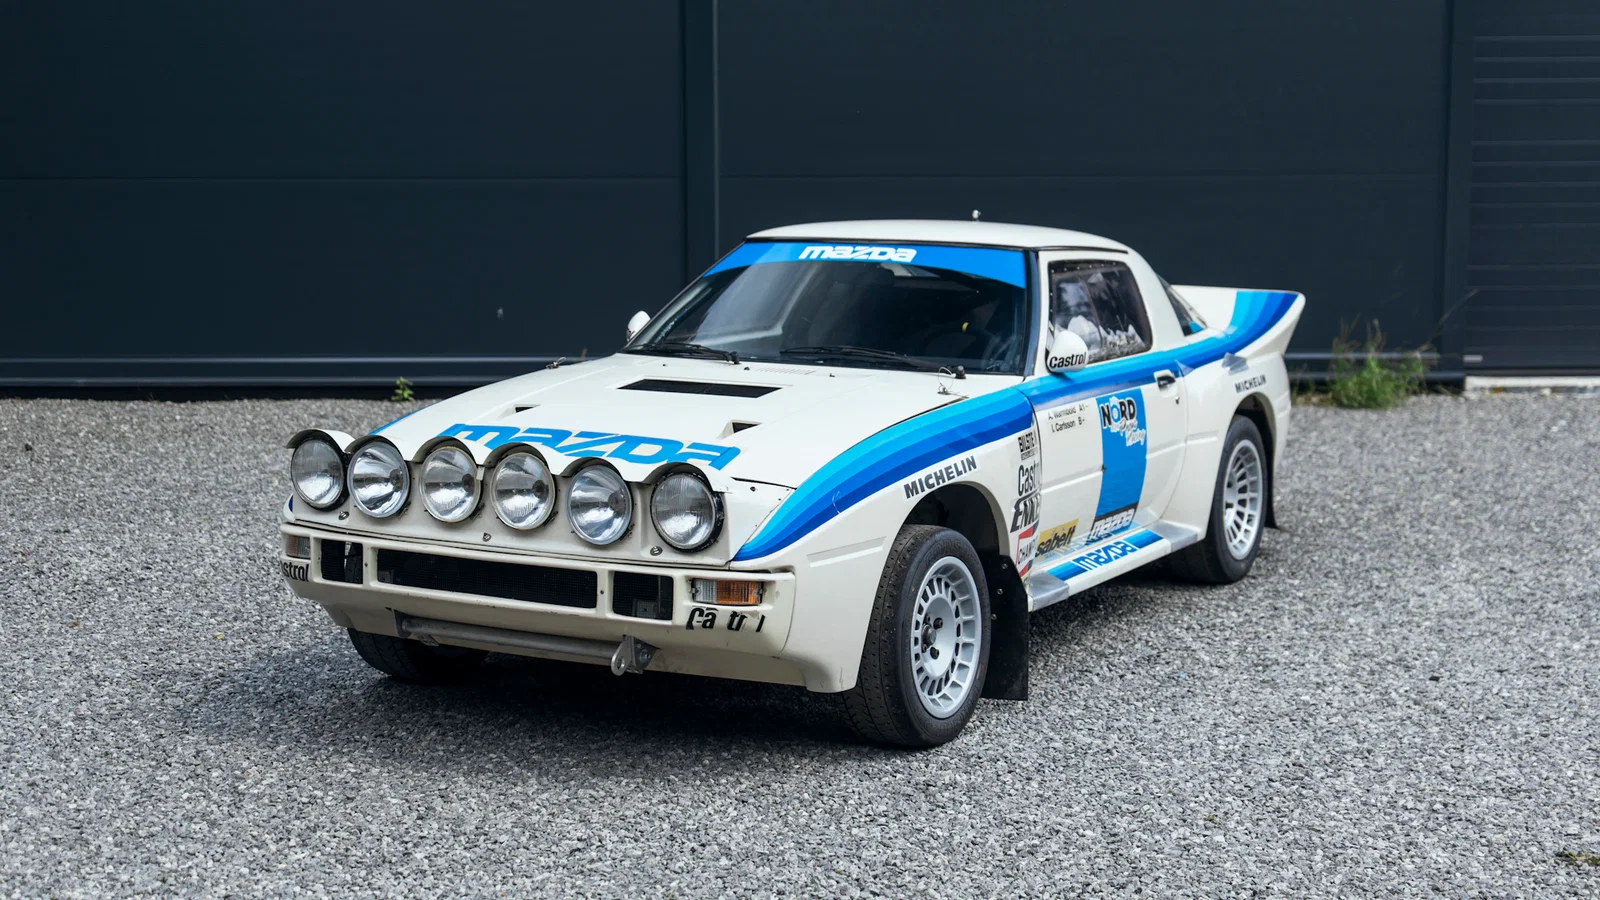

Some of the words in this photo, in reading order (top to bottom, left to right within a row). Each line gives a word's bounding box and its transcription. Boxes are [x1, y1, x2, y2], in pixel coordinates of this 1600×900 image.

[798, 245, 917, 263] mazda
[1049, 351, 1087, 369] Castrol
[1235, 374, 1267, 394] MICHELIN
[1100, 399, 1136, 428] NORD
[436, 424, 741, 471] mazda
[903, 455, 977, 499] MICHELIN
[1035, 527, 1077, 558] sabelt
[1072, 540, 1137, 571] mazda
